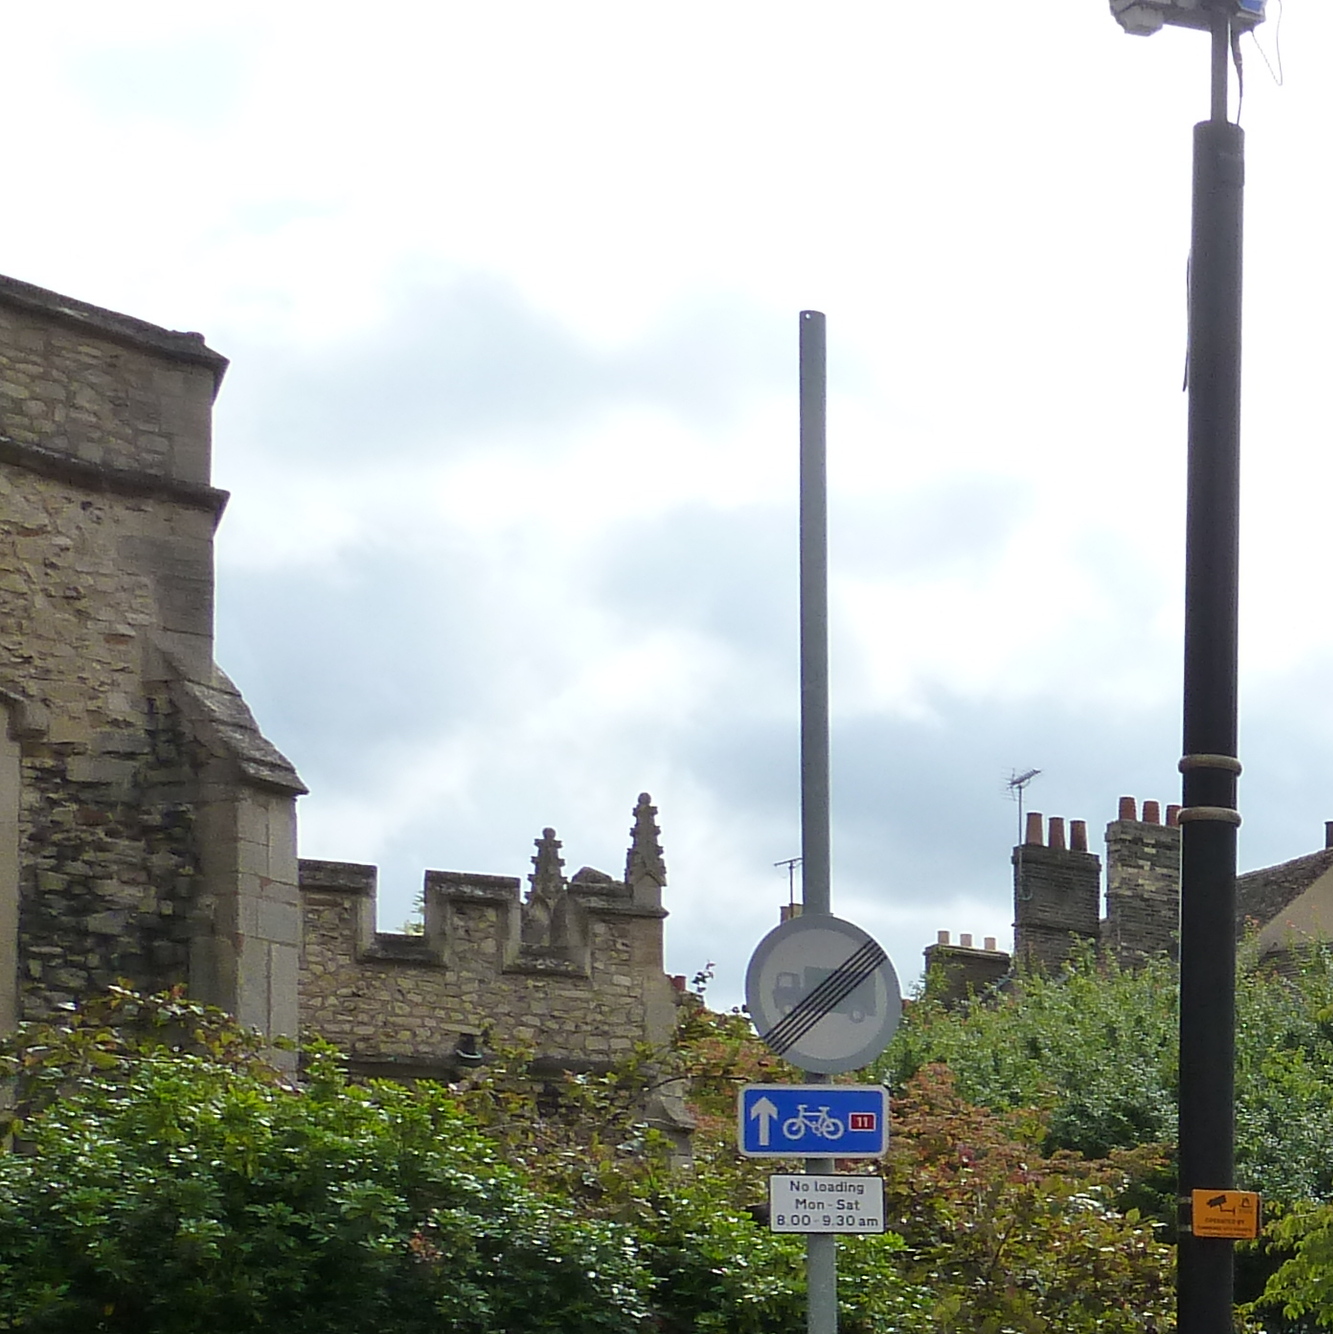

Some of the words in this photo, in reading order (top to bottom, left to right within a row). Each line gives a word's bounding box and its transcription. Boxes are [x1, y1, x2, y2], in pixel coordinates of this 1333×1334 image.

[856, 1117, 868, 1128] 11
[789, 1180, 810, 1192] No
[814, 1181, 865, 1195] loading
[795, 1199, 825, 1210] Mon
[836, 1199, 861, 1211] Sat
[858, 1217, 879, 1226] am
